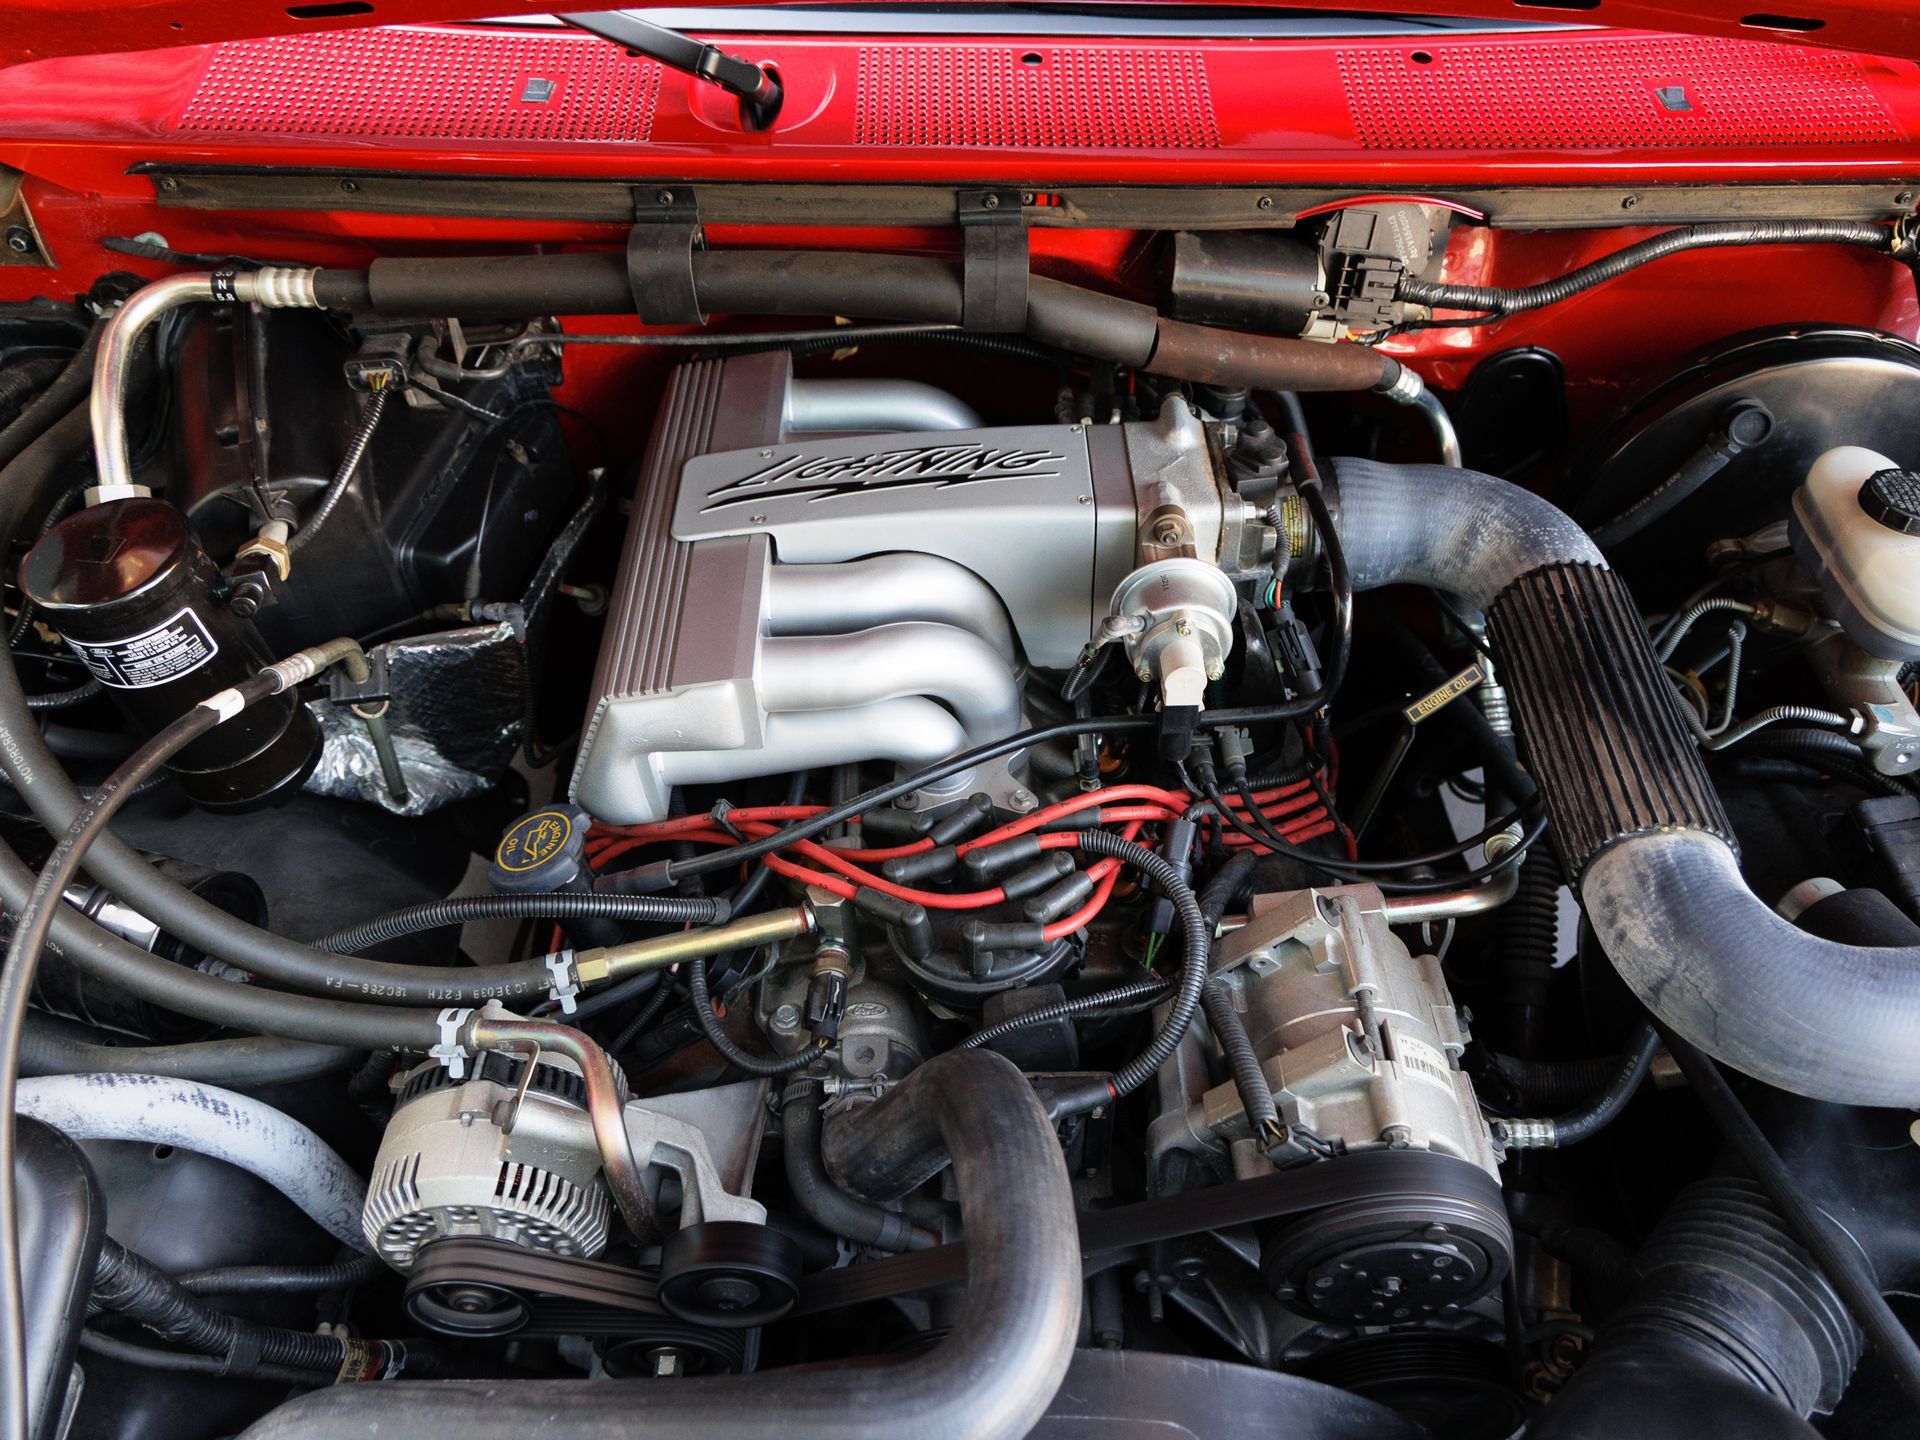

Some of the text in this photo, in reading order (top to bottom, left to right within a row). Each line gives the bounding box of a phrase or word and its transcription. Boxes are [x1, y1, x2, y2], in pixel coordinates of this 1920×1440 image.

[218, 280, 227, 289] N
[706, 443, 1067, 498] LIGHTNING
[1417, 676, 1472, 714] ENGINE OIL
[506, 838, 519, 856] OIL
[540, 821, 561, 856] ENGINE
[428, 990, 462, 1000] F2TH
